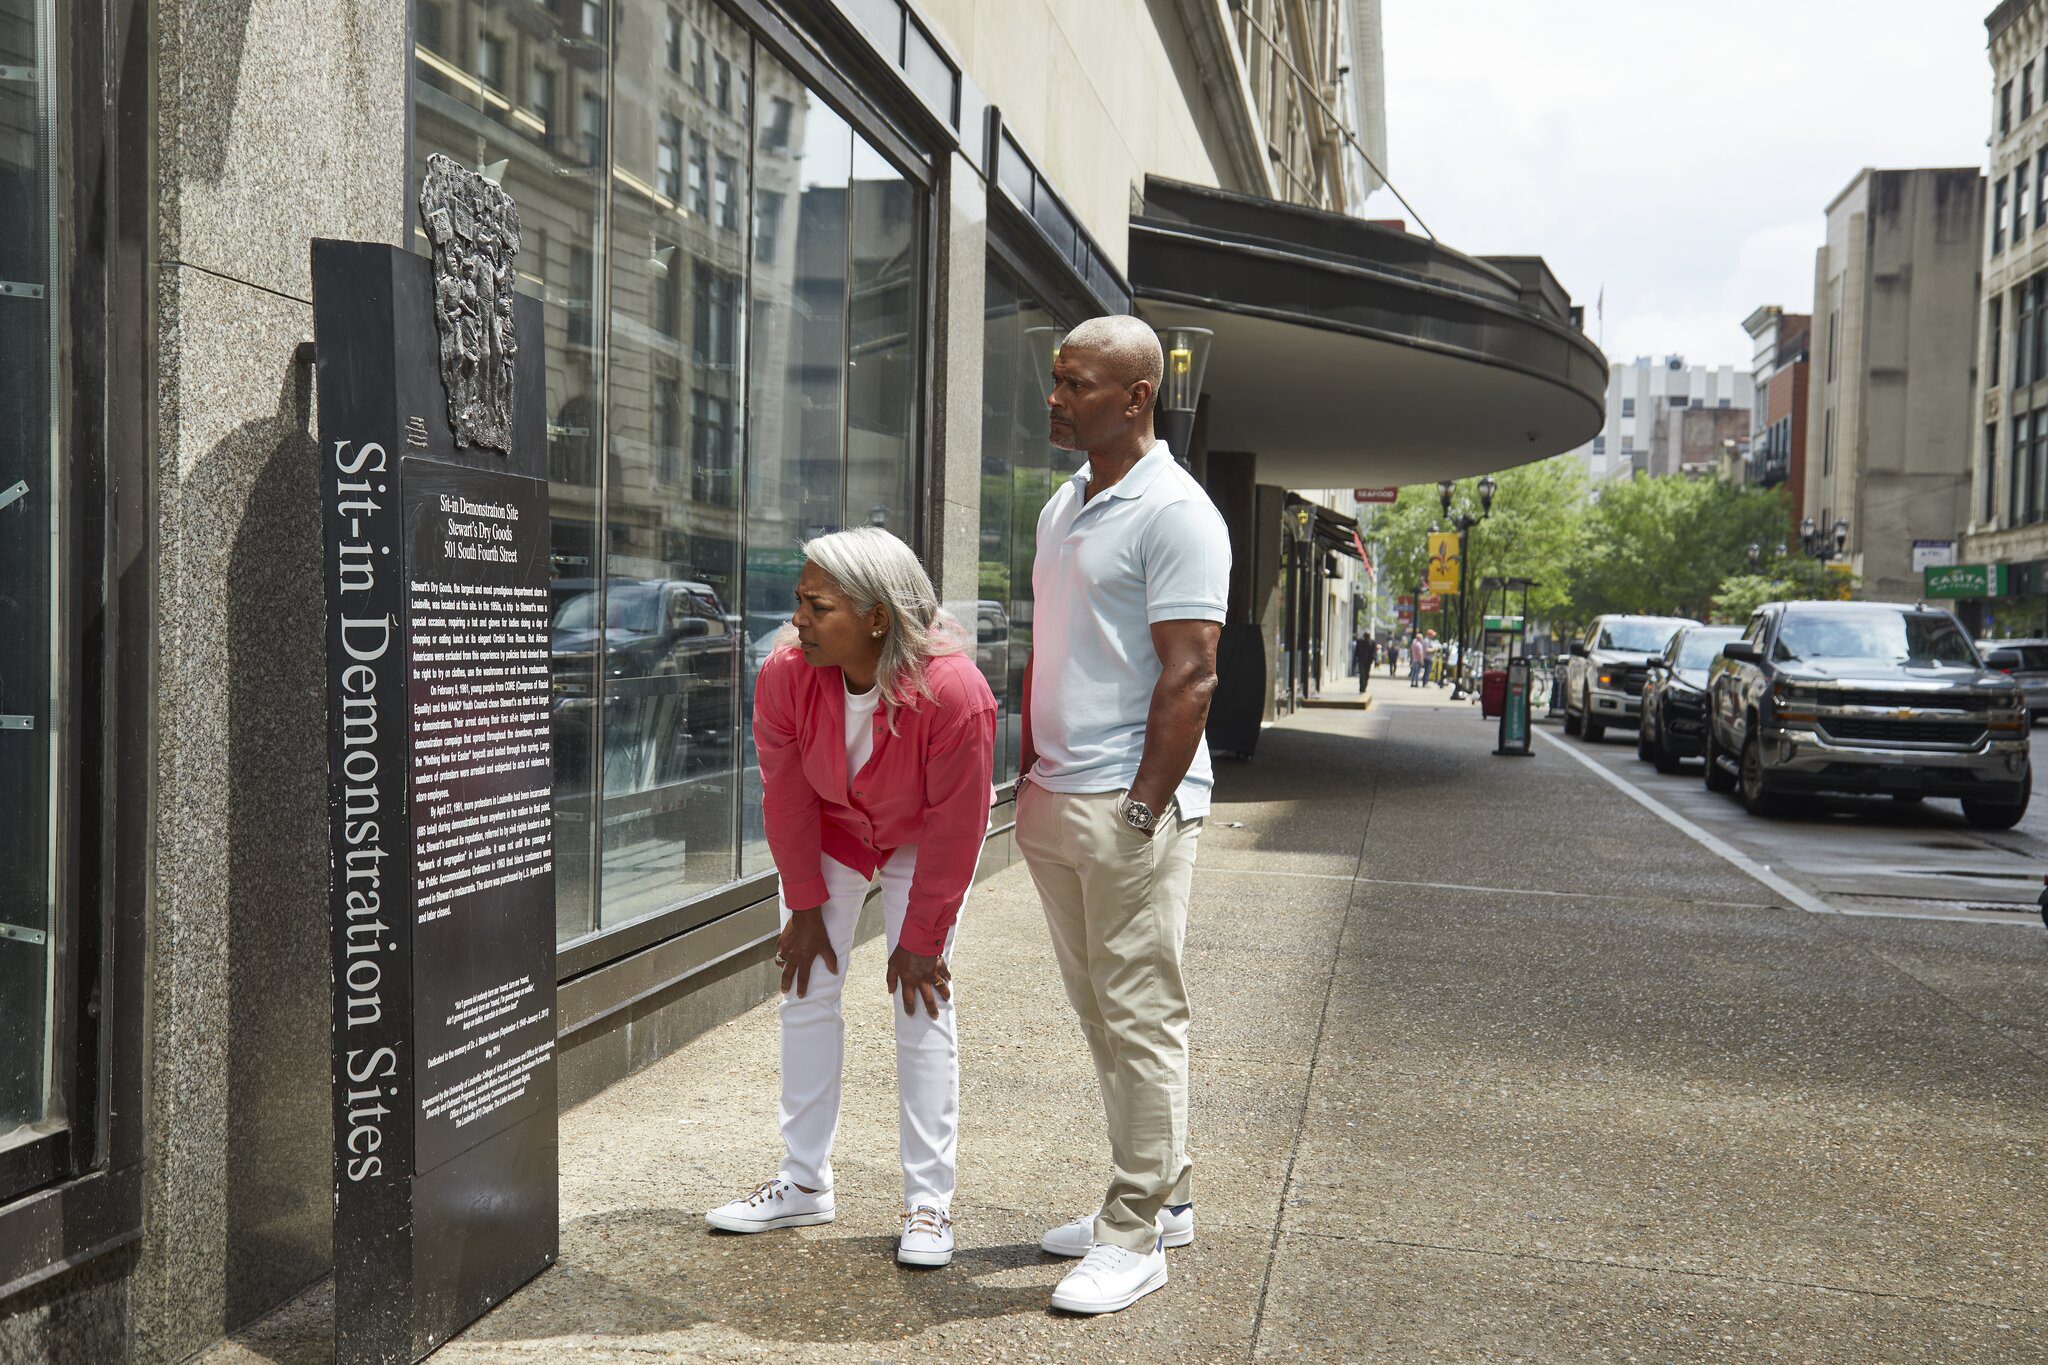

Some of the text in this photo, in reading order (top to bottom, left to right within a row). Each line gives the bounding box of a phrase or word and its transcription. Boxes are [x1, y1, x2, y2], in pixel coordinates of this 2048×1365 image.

[1358, 490, 1394, 498] SEAFOOD
[440, 494, 518, 520] Sit-in Demonstration Site
[448, 518, 512, 543] Stewart's Dry Goods
[445, 541, 517, 563] 501 South Fourth Street
[335, 440, 398, 1182] Sit-in Demonstration Sites
